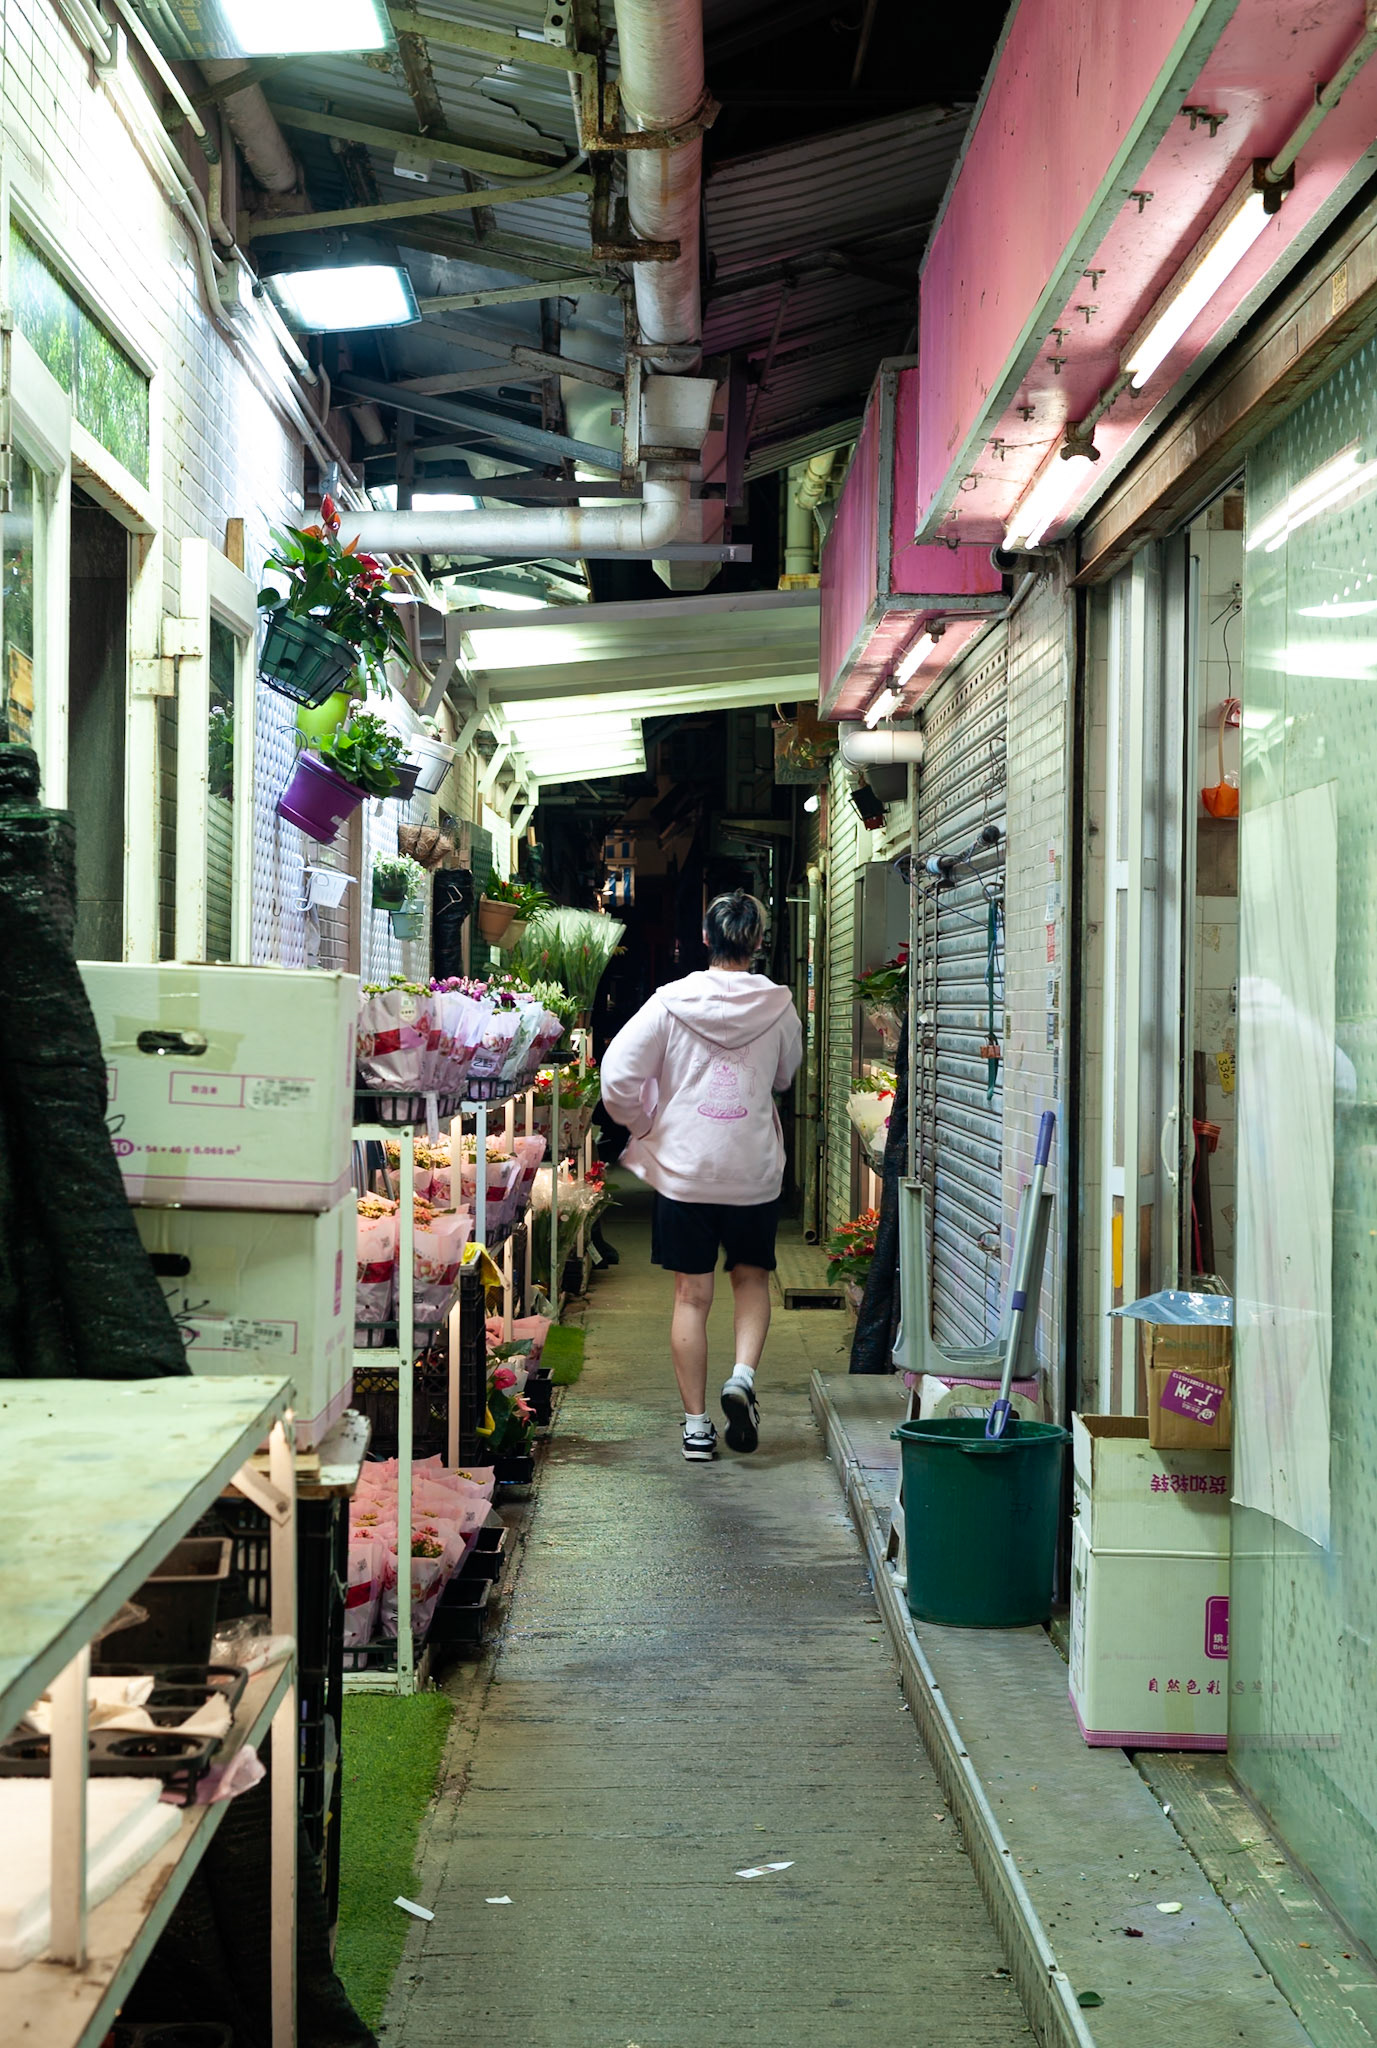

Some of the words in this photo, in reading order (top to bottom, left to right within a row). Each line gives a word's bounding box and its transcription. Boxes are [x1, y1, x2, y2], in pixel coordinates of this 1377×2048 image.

[1174, 1381, 1213, 1405] 广州
[1150, 1473, 1228, 1495] 货如轮转
[1148, 1677, 1220, 1695] 自然色彩
